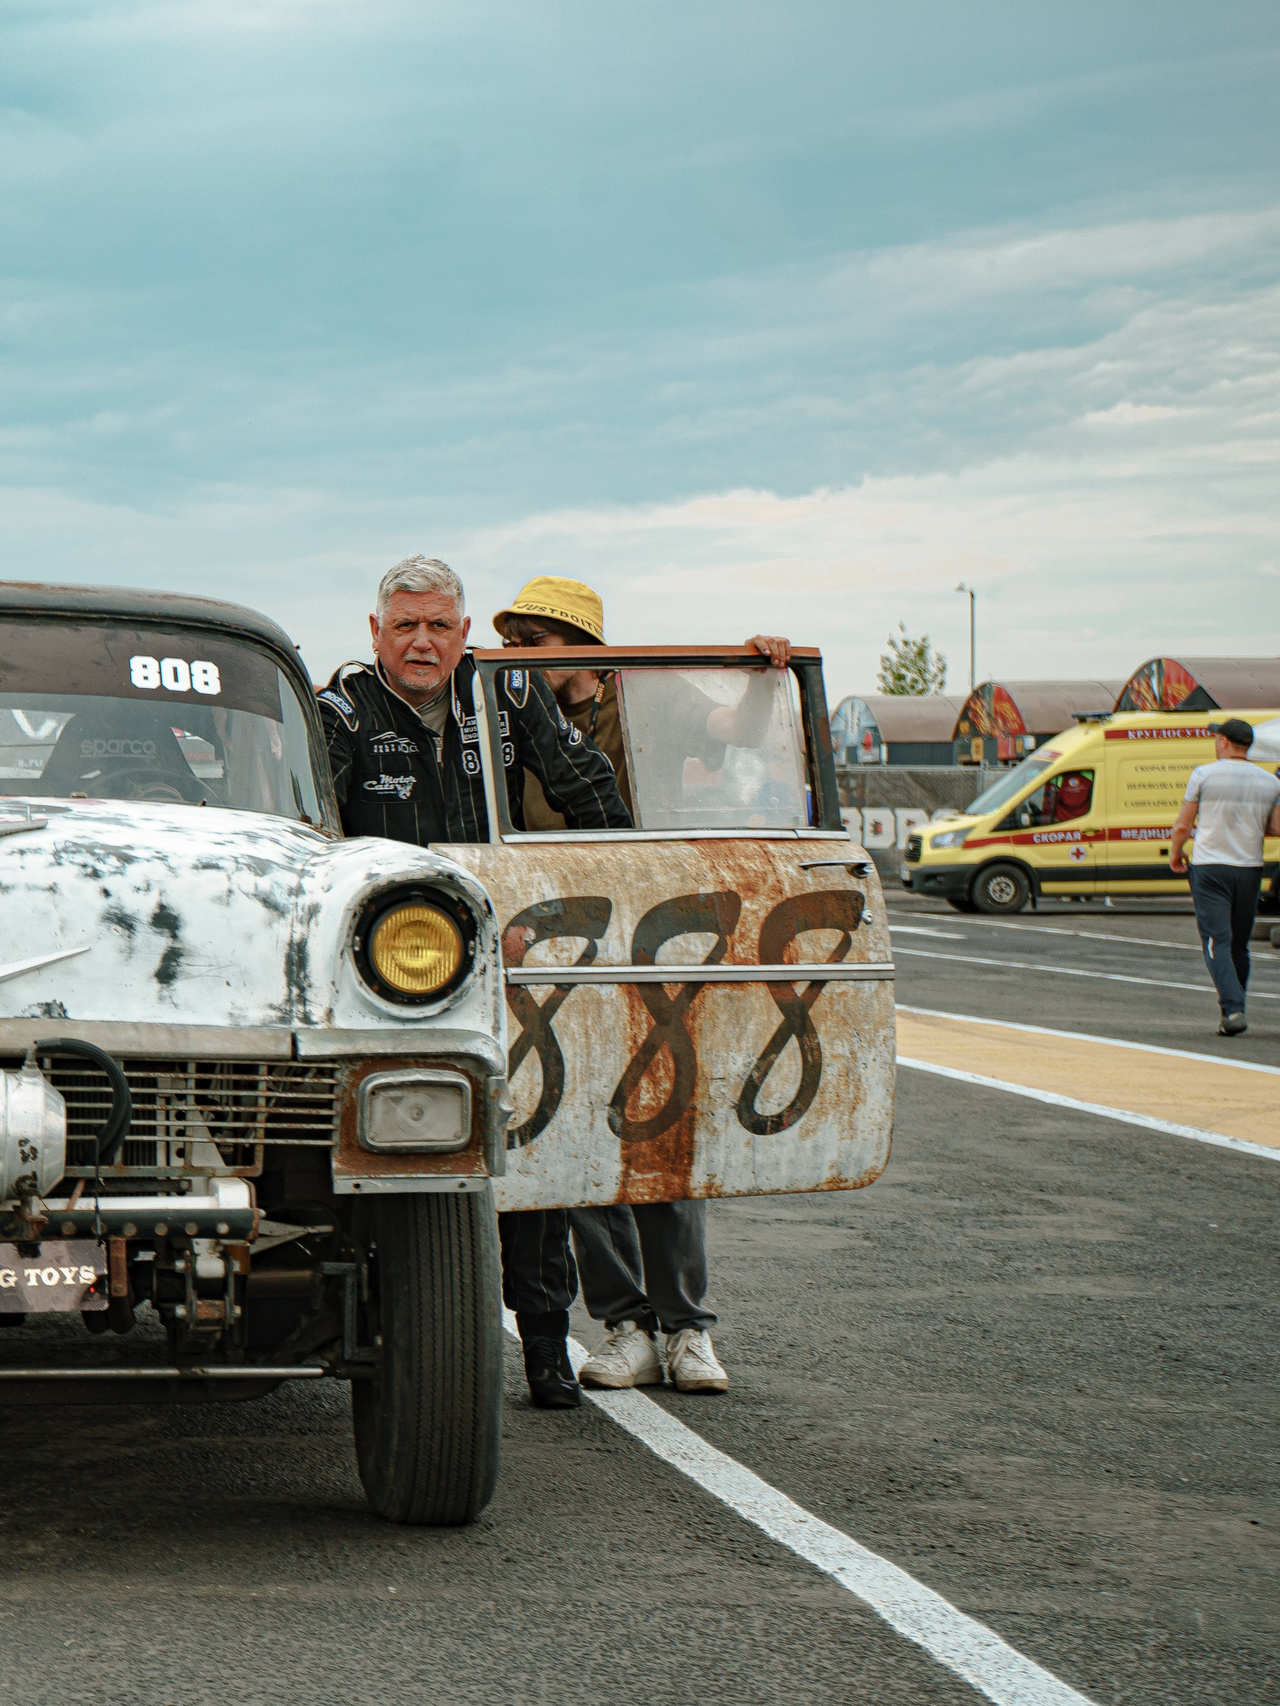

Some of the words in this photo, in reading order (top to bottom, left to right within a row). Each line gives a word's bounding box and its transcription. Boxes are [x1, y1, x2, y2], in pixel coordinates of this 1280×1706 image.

[129, 655, 222, 696] 808
[1127, 728, 1211, 740] КРУГЛОСУТО
[80, 737, 157, 757] sparco
[363, 780, 396, 791] Cats
[379, 774, 417, 785] Motor
[1033, 831, 1082, 844] СКОРАЯ
[1121, 828, 1174, 841] МЕДИЦИ
[23, 1265, 98, 1287] TOYS
